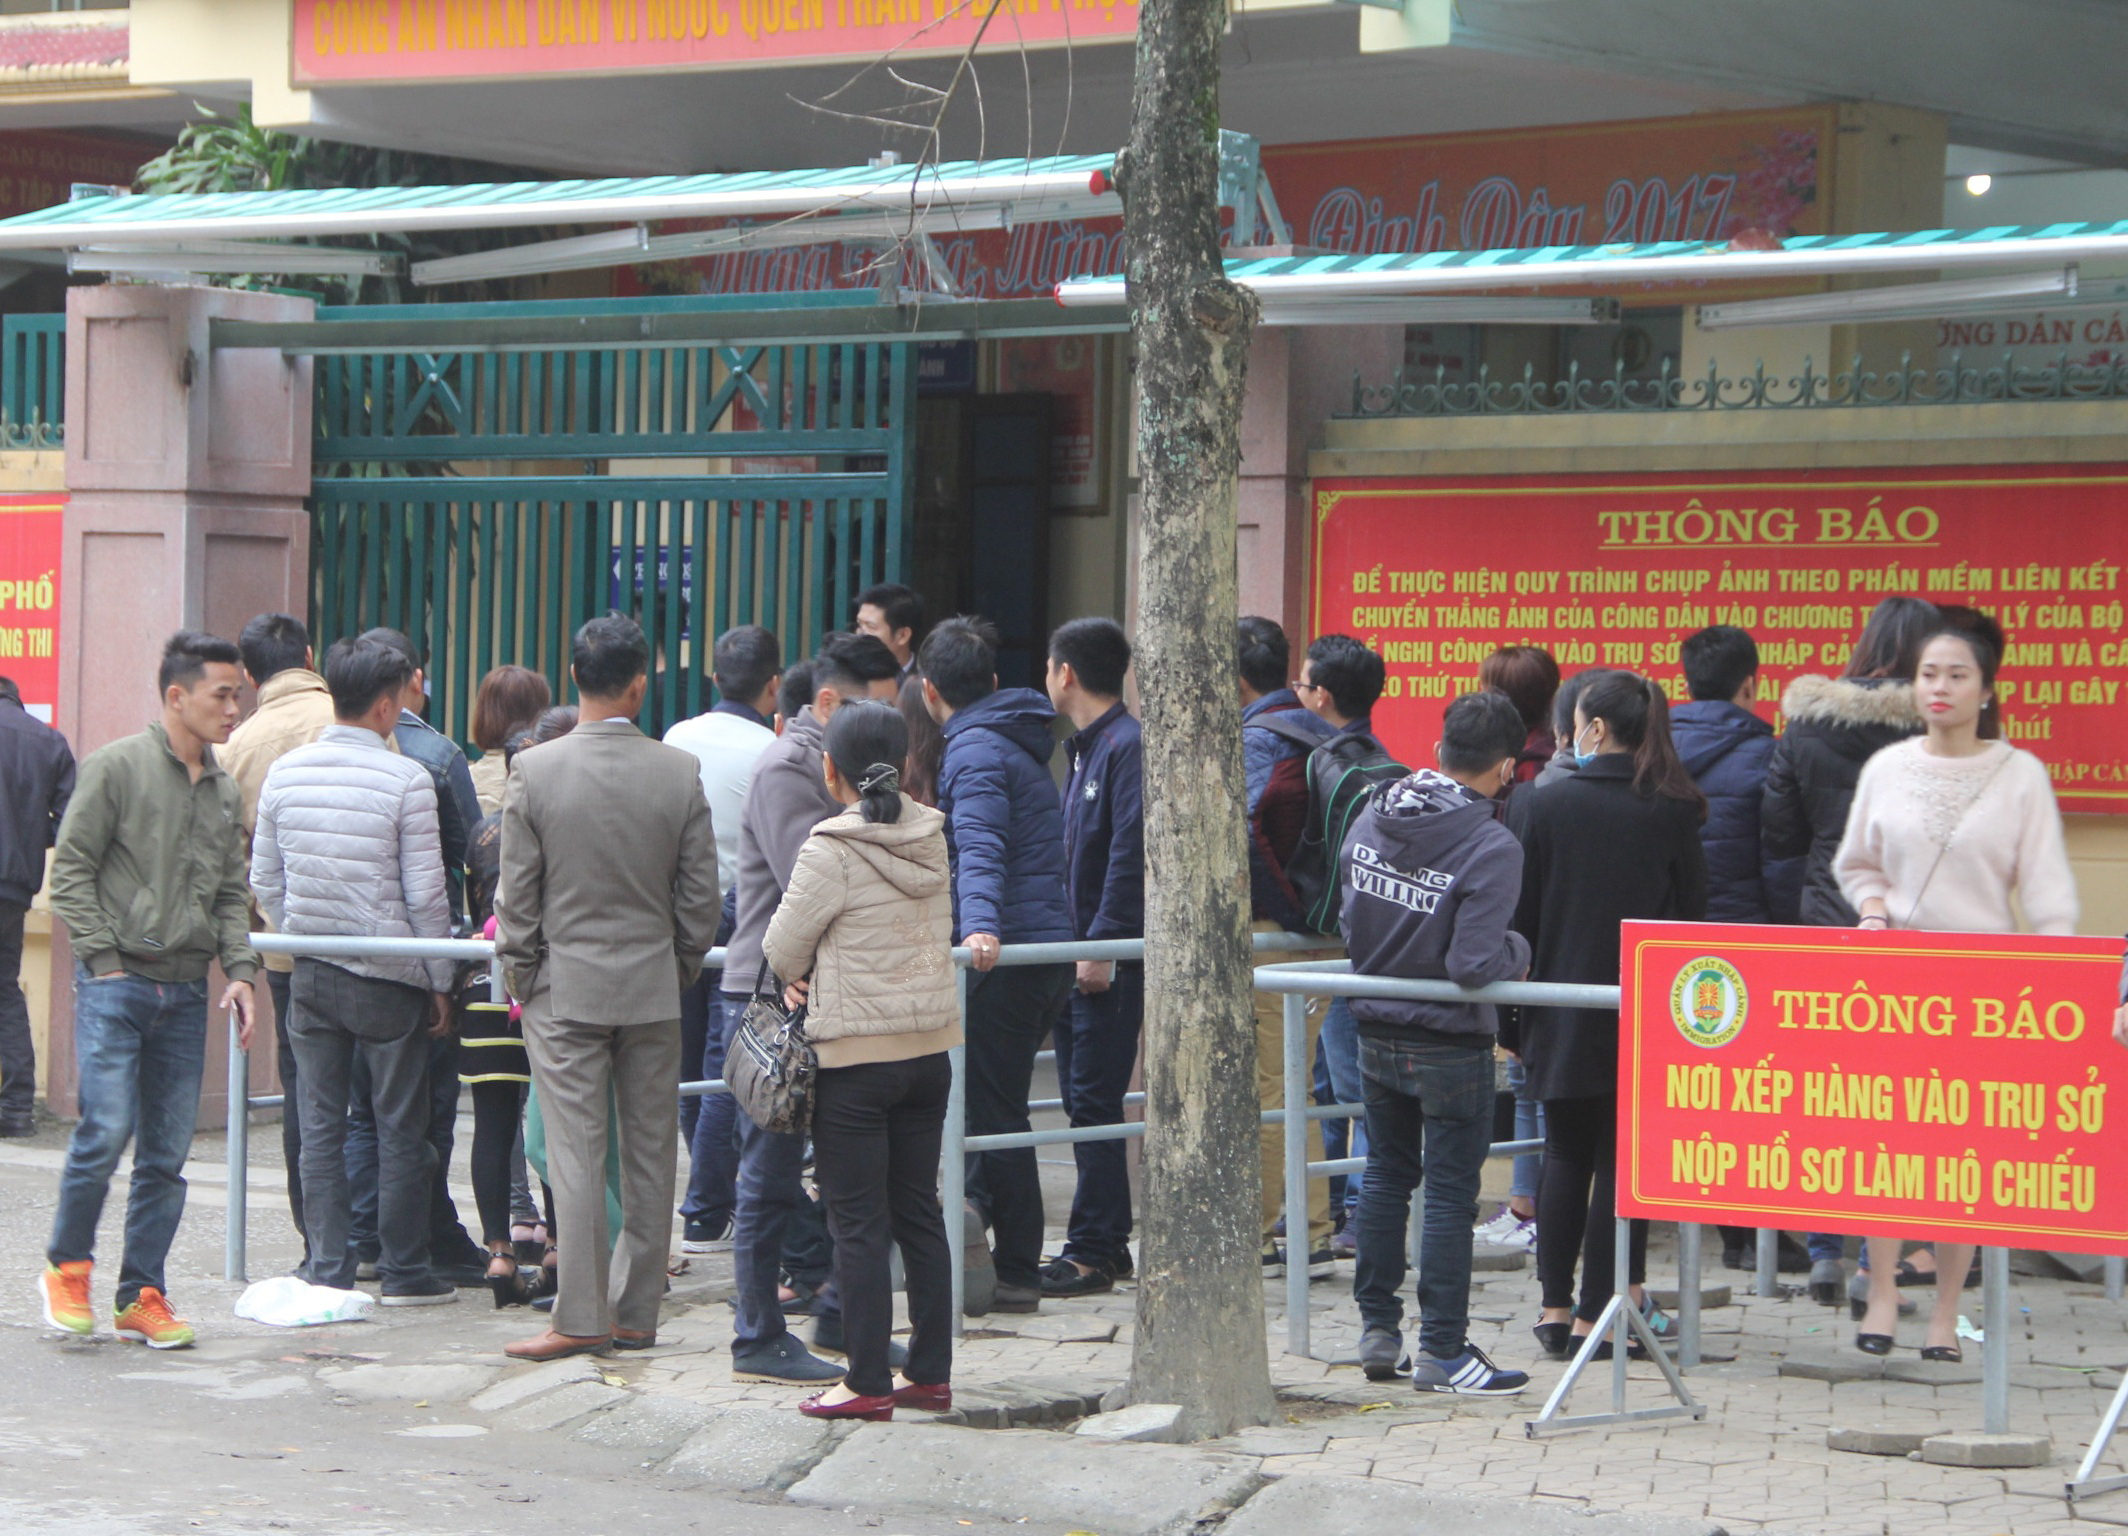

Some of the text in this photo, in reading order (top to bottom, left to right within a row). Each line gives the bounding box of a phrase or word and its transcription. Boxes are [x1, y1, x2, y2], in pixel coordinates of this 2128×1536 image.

[1602, 173, 1737, 243] 2017
[2083, 310, 2128, 344] CÁ
[1598, 495, 1939, 544] THÔNG BÁO
[1388, 570, 1446, 598] THỰC
[1453, 567, 1508, 598] HIỆN
[1514, 571, 1560, 595] QUY
[1567, 566, 1638, 593] TRÌNH
[1645, 570, 1711, 597] CHỤP
[1718, 560, 1770, 592] ẢNH
[1778, 569, 1840, 592] THEO
[2001, 562, 2060, 591] LIÊN
[2069, 558, 2120, 591] KẾT
[1352, 598, 1429, 628] CHUYỂN
[1506, 598, 1548, 628] ẢNH
[1554, 598, 1595, 629] CỦA
[1602, 602, 1659, 629] CÔNG
[1665, 601, 1709, 629] DÂN
[1715, 601, 1757, 629] VÀO
[1764, 604, 1853, 629] CHƯƠNG
[2002, 601, 2029, 628] LÝ
[2036, 596, 2084, 629] CỦA
[2090, 600, 2124, 633] BỘ
[27, 628, 52, 657] THI
[1383, 641, 1434, 668] NGHỊ
[1554, 638, 1596, 664] VÀO
[1602, 642, 1644, 669] TRỤ
[1650, 633, 1683, 664] SỞ
[2060, 638, 2093, 666] VÀ
[1408, 670, 1450, 697] THỨ
[2023, 681, 2062, 709] LẠI
[2069, 676, 2120, 705] GÂY
[2002, 713, 2053, 740] hút
[1773, 980, 2085, 1042] THÔNG BÁO
[1666, 1053, 2107, 1141] NƠI XẾP HÀNG VÀO TRỤ SỞ
[1671, 1130, 2096, 1215] NỘP HỒ SƠ LÀM HỘ CHIẾU
